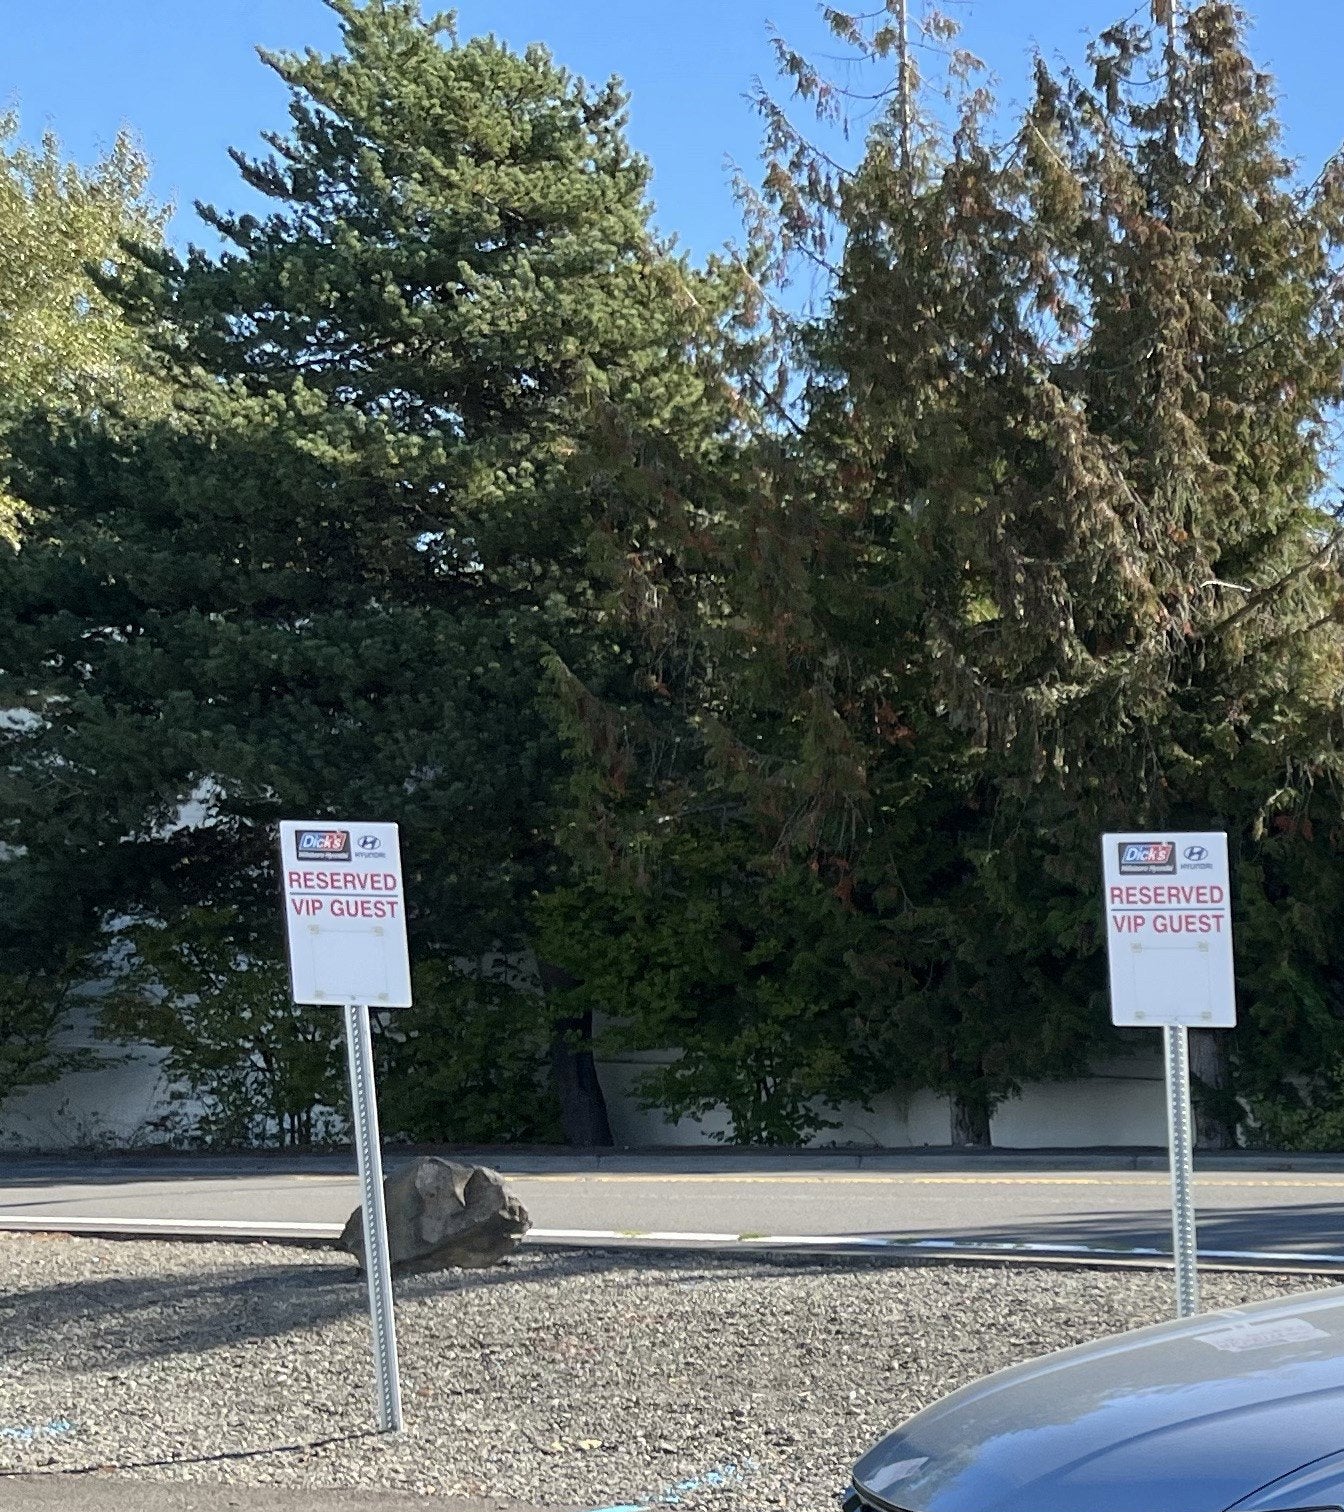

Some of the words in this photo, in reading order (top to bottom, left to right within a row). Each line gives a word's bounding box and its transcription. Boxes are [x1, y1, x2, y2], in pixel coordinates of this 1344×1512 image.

[289, 871, 397, 891] RESERVED
[1110, 885, 1224, 904] RESERVED
[292, 899, 323, 916] VIP
[331, 900, 398, 918] GUEST
[1113, 915, 1145, 933] VIP
[1153, 915, 1224, 934] GUEST
